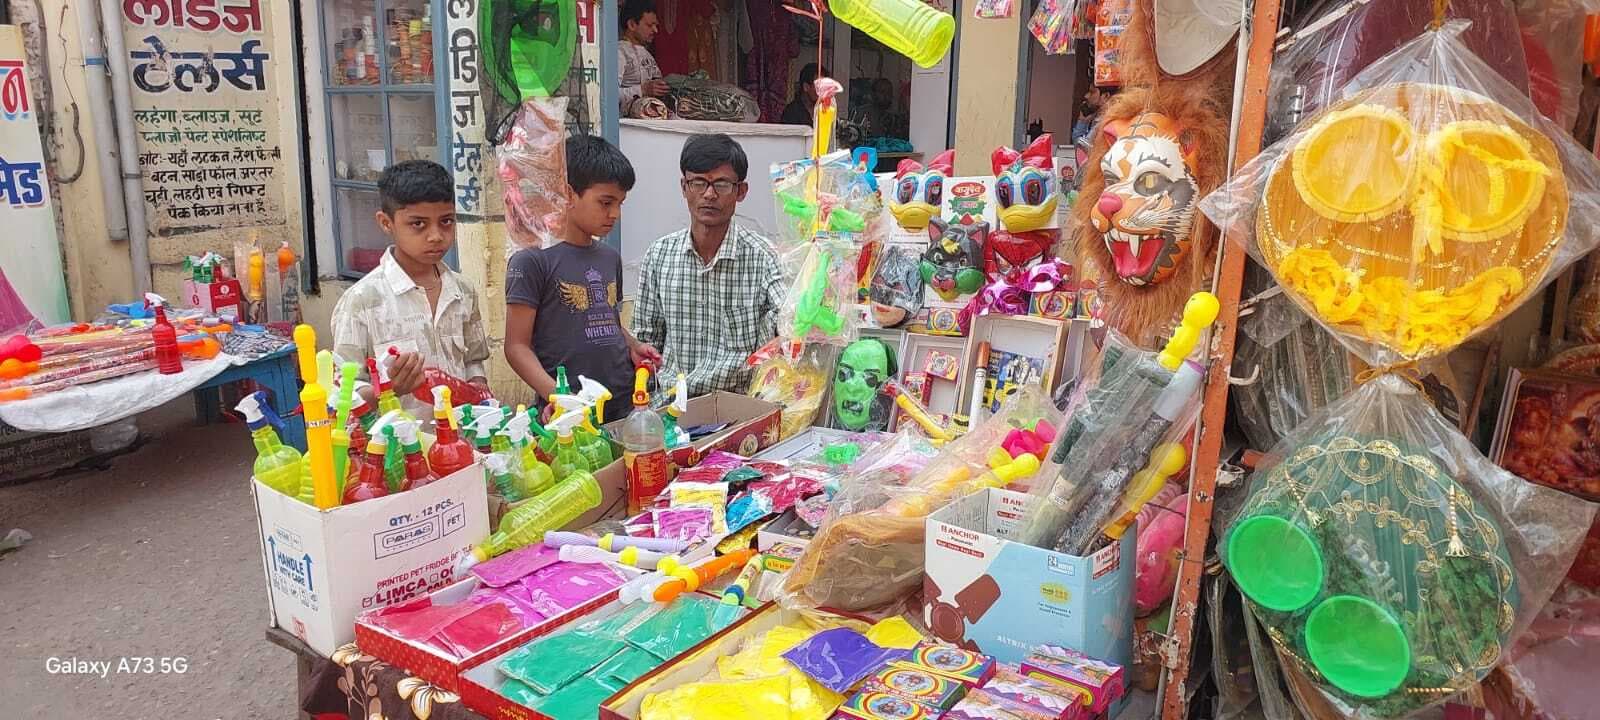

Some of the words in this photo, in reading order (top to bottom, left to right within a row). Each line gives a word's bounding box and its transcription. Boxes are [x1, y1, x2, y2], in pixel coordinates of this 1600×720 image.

[130, 35, 269, 93] टेलर्स
[389, 513, 413, 527] QTY.
[422, 506, 433, 517] 12
[435, 499, 454, 512] PCS.
[447, 514, 461, 527] PET
[948, 527, 979, 541] ANCHOR
[277, 552, 304, 576] HANDLE
[377, 573, 409, 589] PRINTED
[410, 567, 423, 578] PET
[425, 557, 449, 572] FRIDGE
[376, 579, 427, 604] LIMCA
